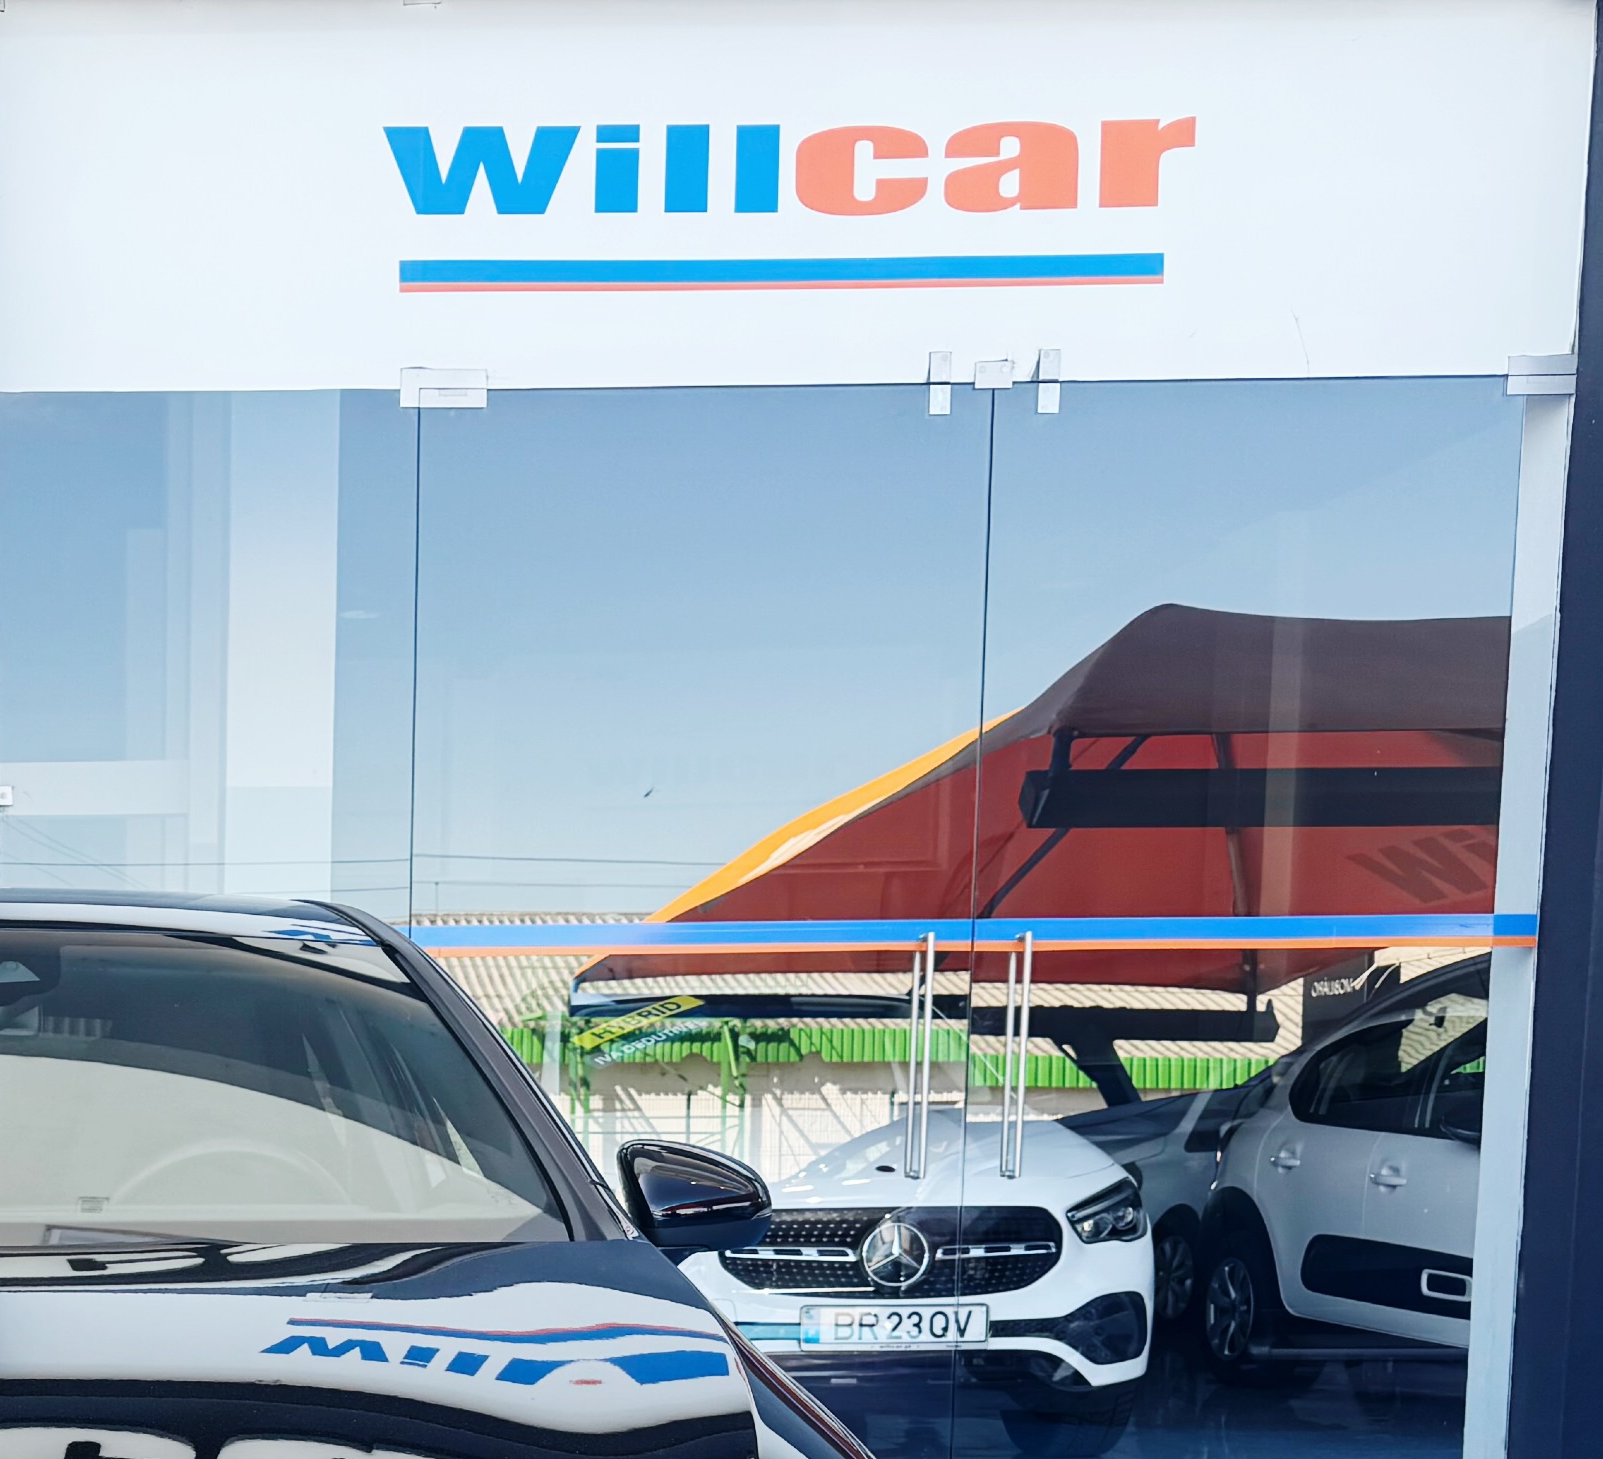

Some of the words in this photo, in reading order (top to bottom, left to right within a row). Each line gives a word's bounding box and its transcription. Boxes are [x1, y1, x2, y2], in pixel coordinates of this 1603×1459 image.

[382, 115, 1197, 216] willcar
[590, 1001, 682, 1040] HYBRID
[594, 1050, 623, 1066] IVA
